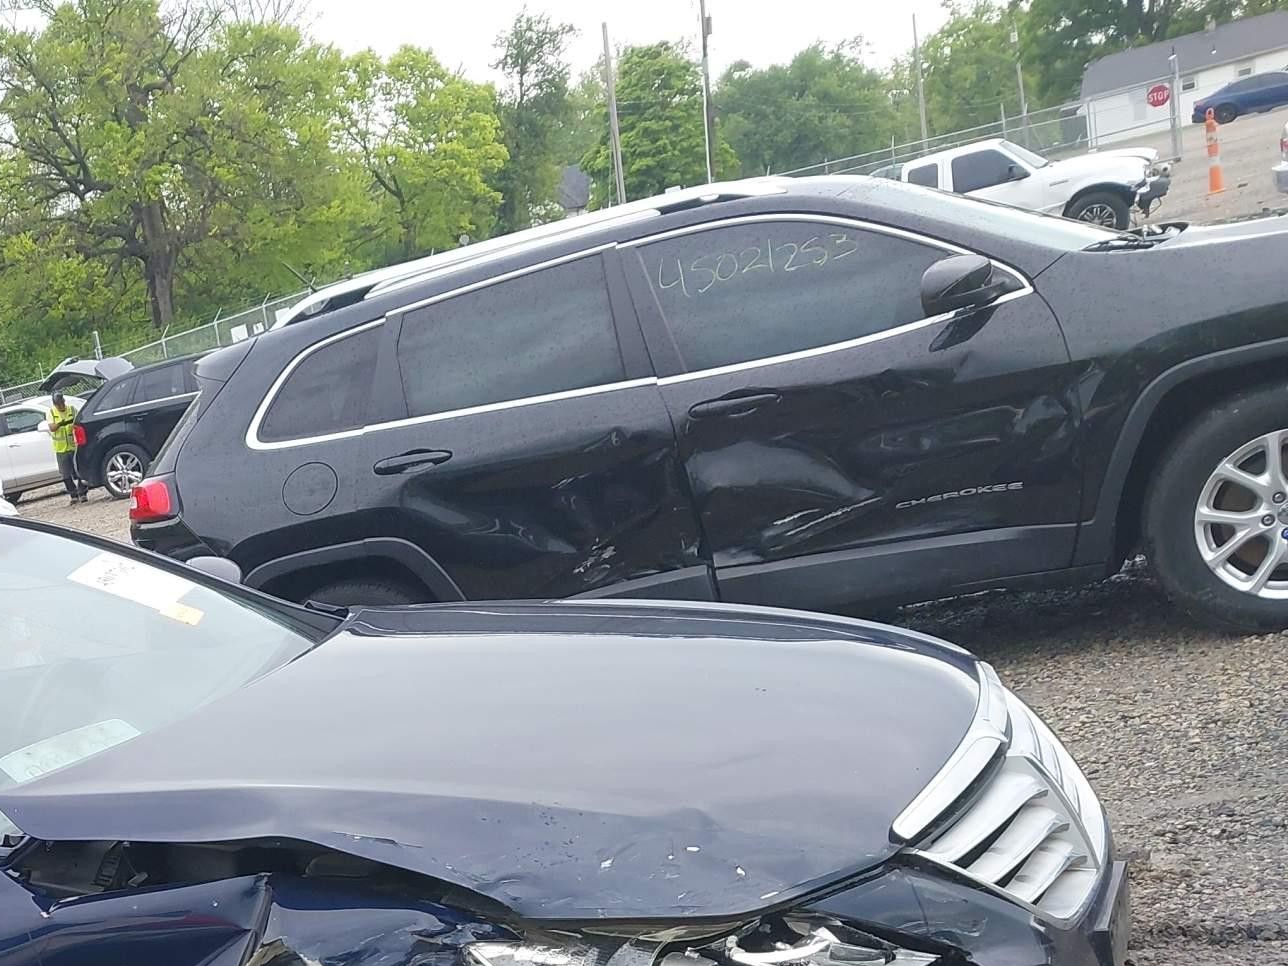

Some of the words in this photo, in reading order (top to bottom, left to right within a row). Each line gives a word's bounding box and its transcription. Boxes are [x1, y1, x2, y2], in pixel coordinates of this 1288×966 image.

[1148, 90, 1169, 102] STOP
[658, 233, 859, 298] 45021253
[895, 481, 1024, 509] CHEROKEE
